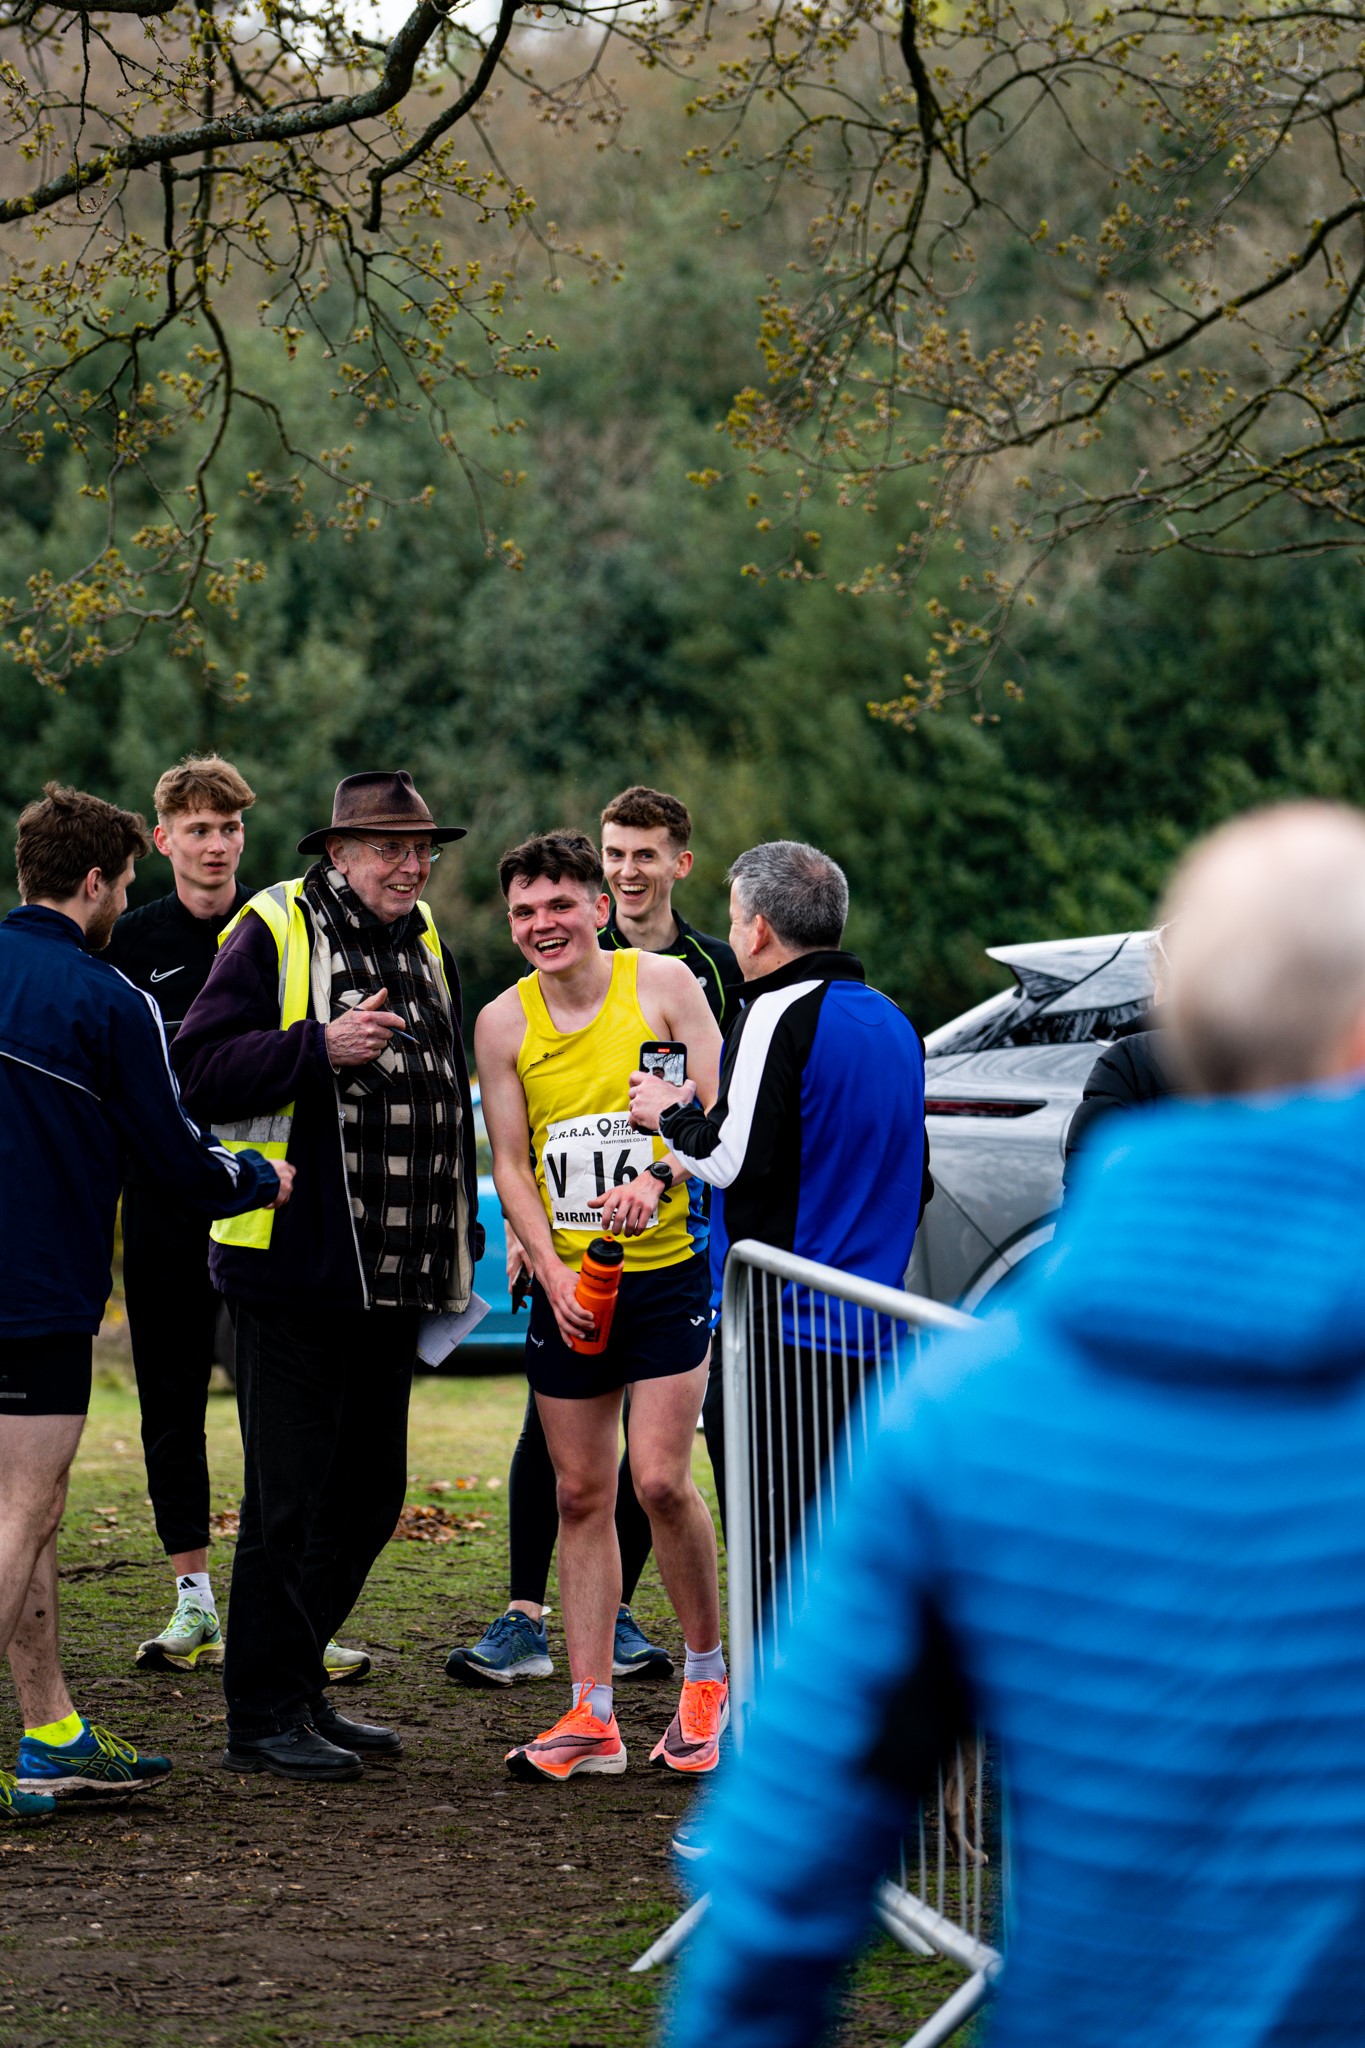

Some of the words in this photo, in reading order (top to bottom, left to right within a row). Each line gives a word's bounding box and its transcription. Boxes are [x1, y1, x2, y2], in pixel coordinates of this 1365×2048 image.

[613, 1119, 630, 1129] STA
[601, 1137, 648, 1145] STARTFITNESS.CO.UK
[546, 1152, 567, 1198] V
[593, 1149, 639, 1197] 16
